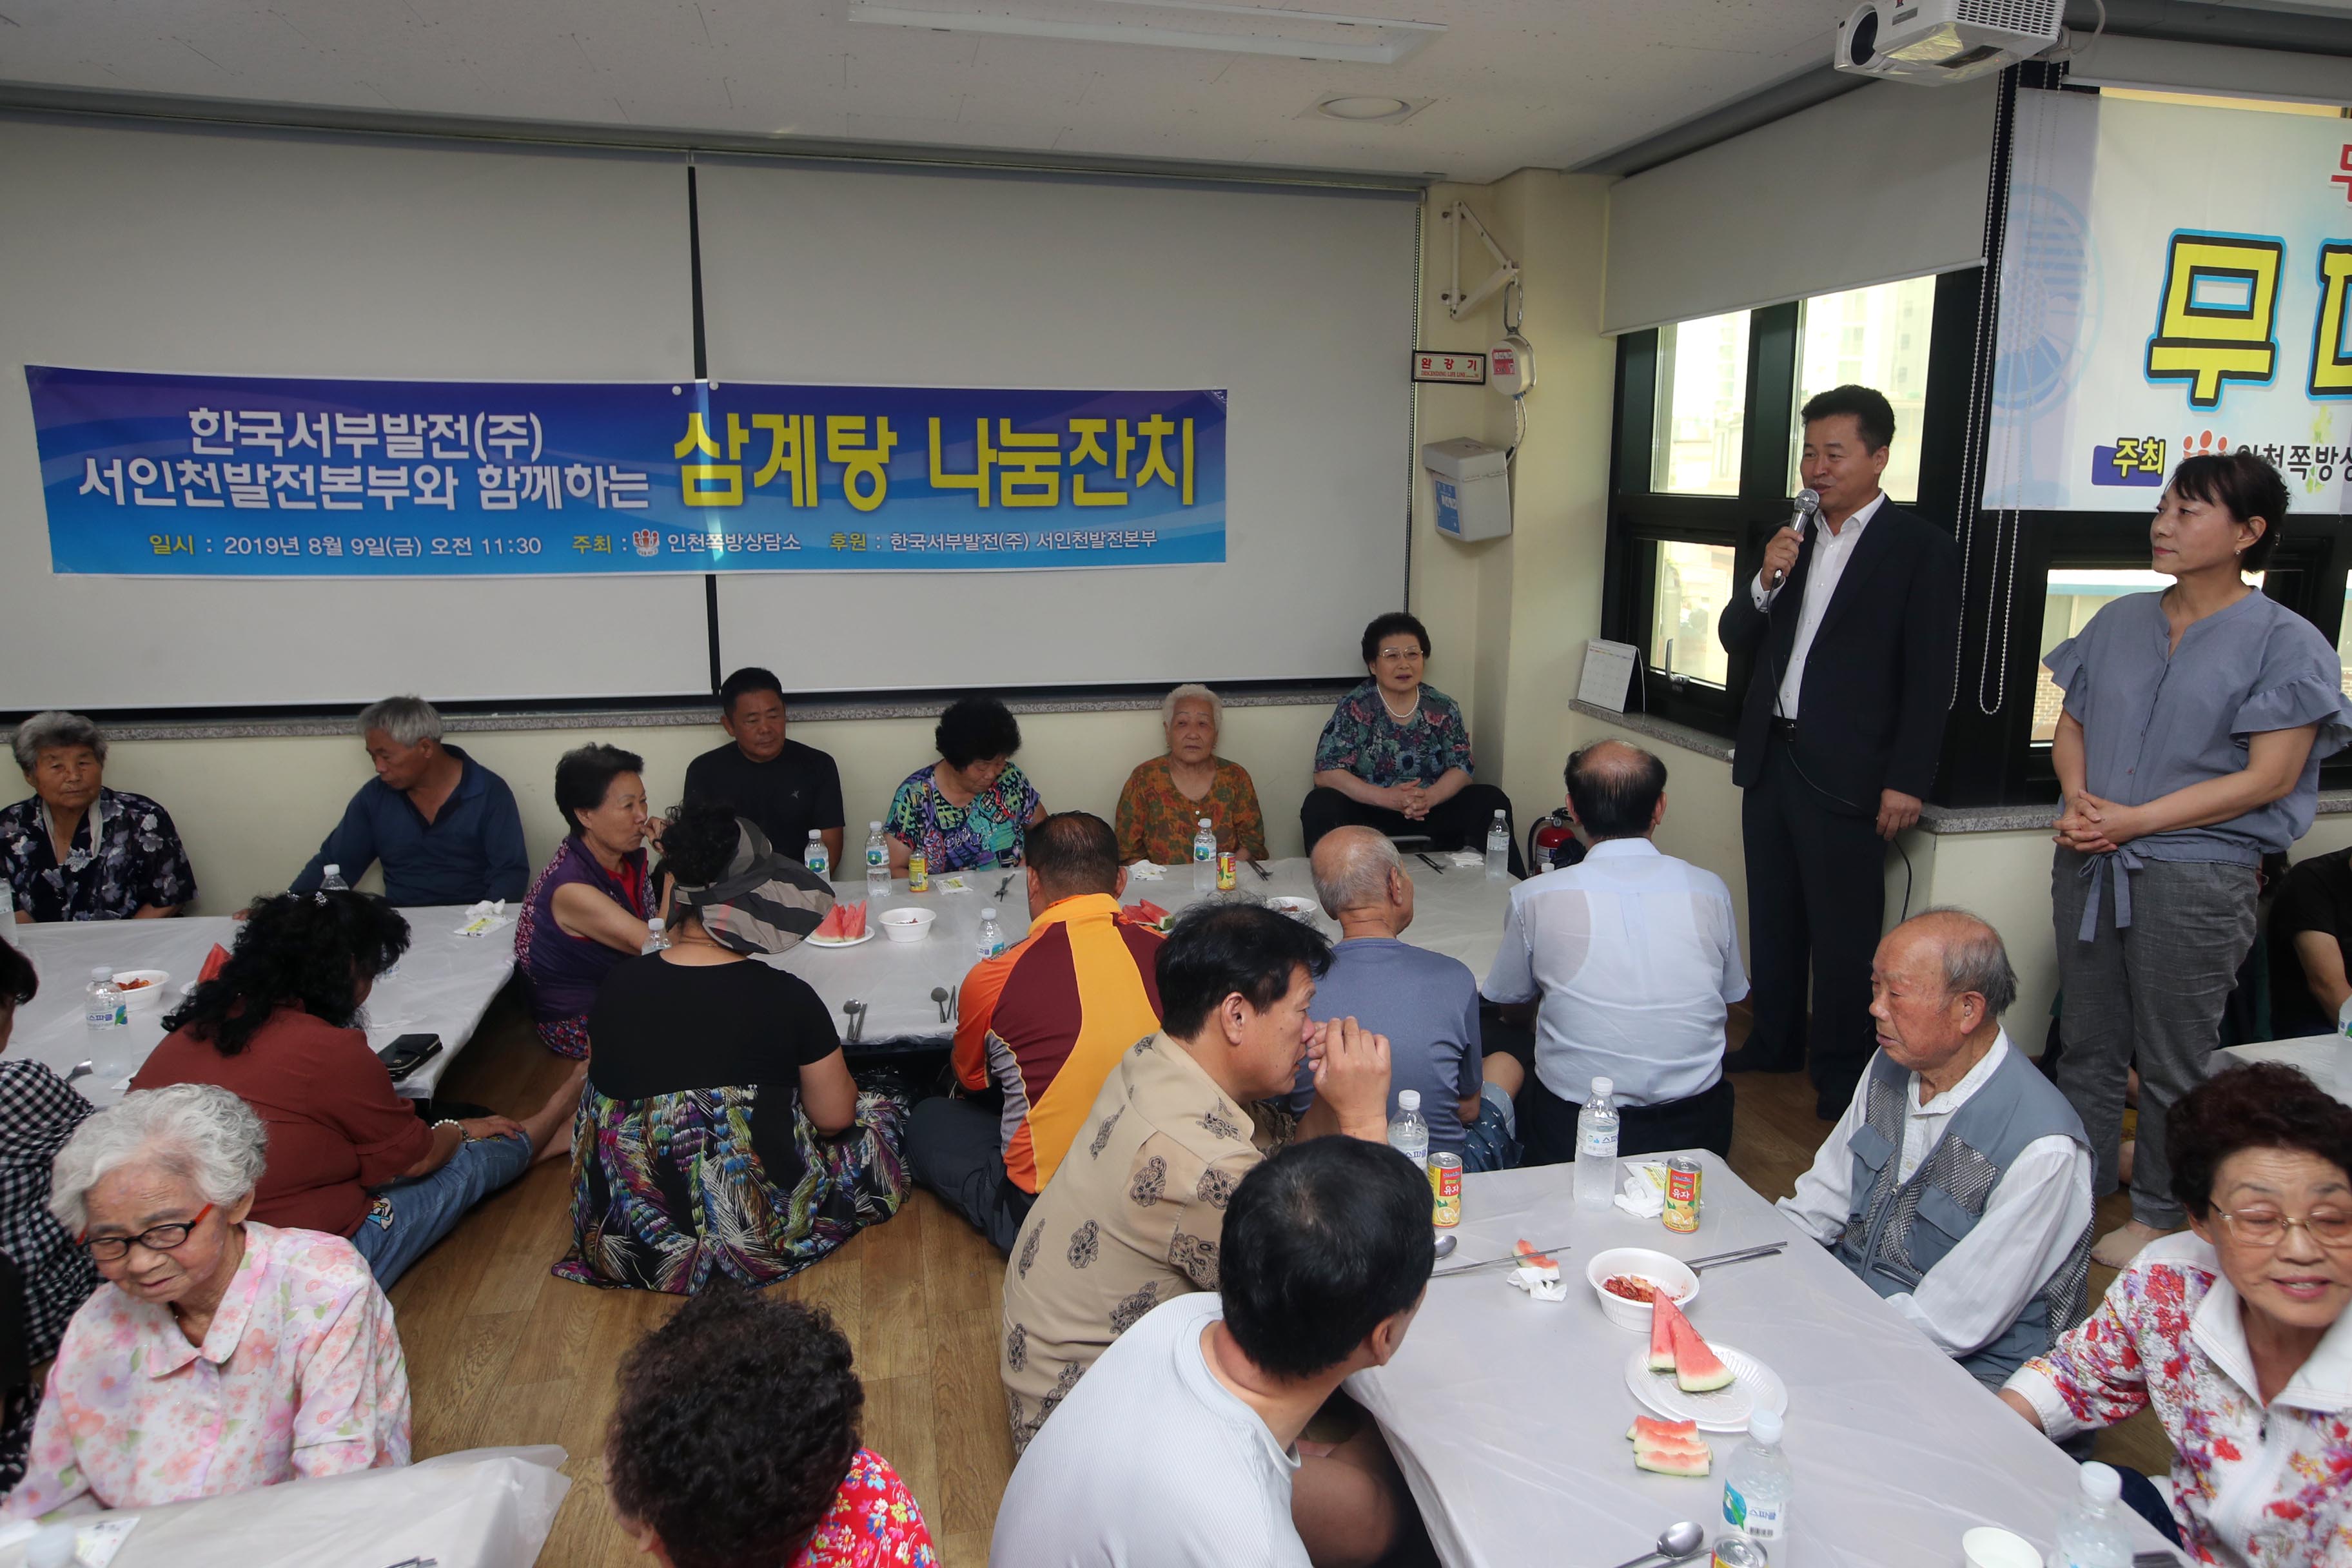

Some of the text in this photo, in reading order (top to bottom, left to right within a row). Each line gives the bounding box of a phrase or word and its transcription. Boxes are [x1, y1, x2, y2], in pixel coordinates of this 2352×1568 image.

[188, 406, 544, 462] 한국서부발전(주)
[674, 411, 1195, 512] 삼계탕 나눔잔치
[2113, 437, 2166, 478] 주최
[78, 456, 650, 511] 서인천발전본부와 함께하는
[149, 534, 195, 556] 일시
[224, 536, 300, 556] 2019년
[308, 536, 343, 556] 8월
[351, 536, 422, 558] 9일(금)
[431, 536, 473, 556] 오전
[482, 538, 542, 555] 11:30
[571, 534, 612, 556] 주최
[667, 531, 801, 553] 인천쪽방상담소
[829, 532, 867, 552] 후원
[890, 531, 1030, 553] 한국서부발전(주)
[1035, 529, 1158, 551] 서인천발전본부
[1444, 1184, 1460, 1195] 유자
[1672, 1188, 1690, 1199] 유자
